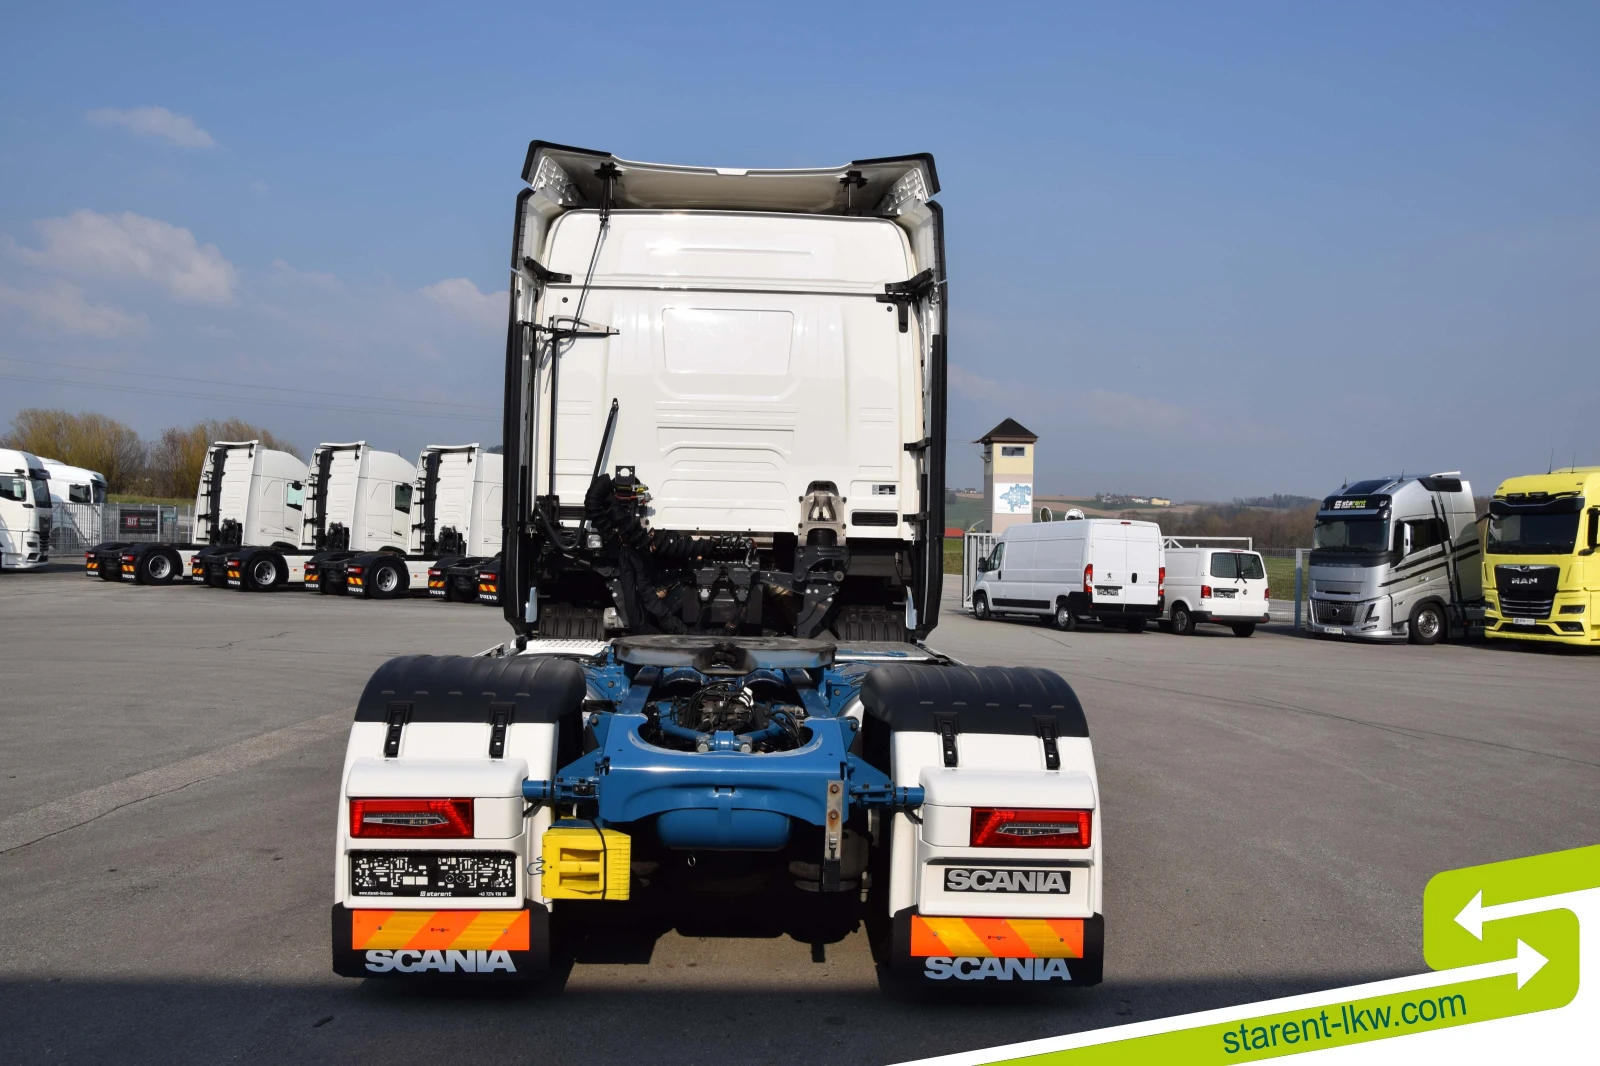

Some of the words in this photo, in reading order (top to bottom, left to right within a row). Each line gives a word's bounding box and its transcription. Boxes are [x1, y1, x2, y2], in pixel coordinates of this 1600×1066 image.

[127, 517, 137, 526] BIT
[947, 869, 1068, 892] SCANIA
[365, 949, 517, 973] SCANIA
[924, 956, 1072, 981] SCANIA
